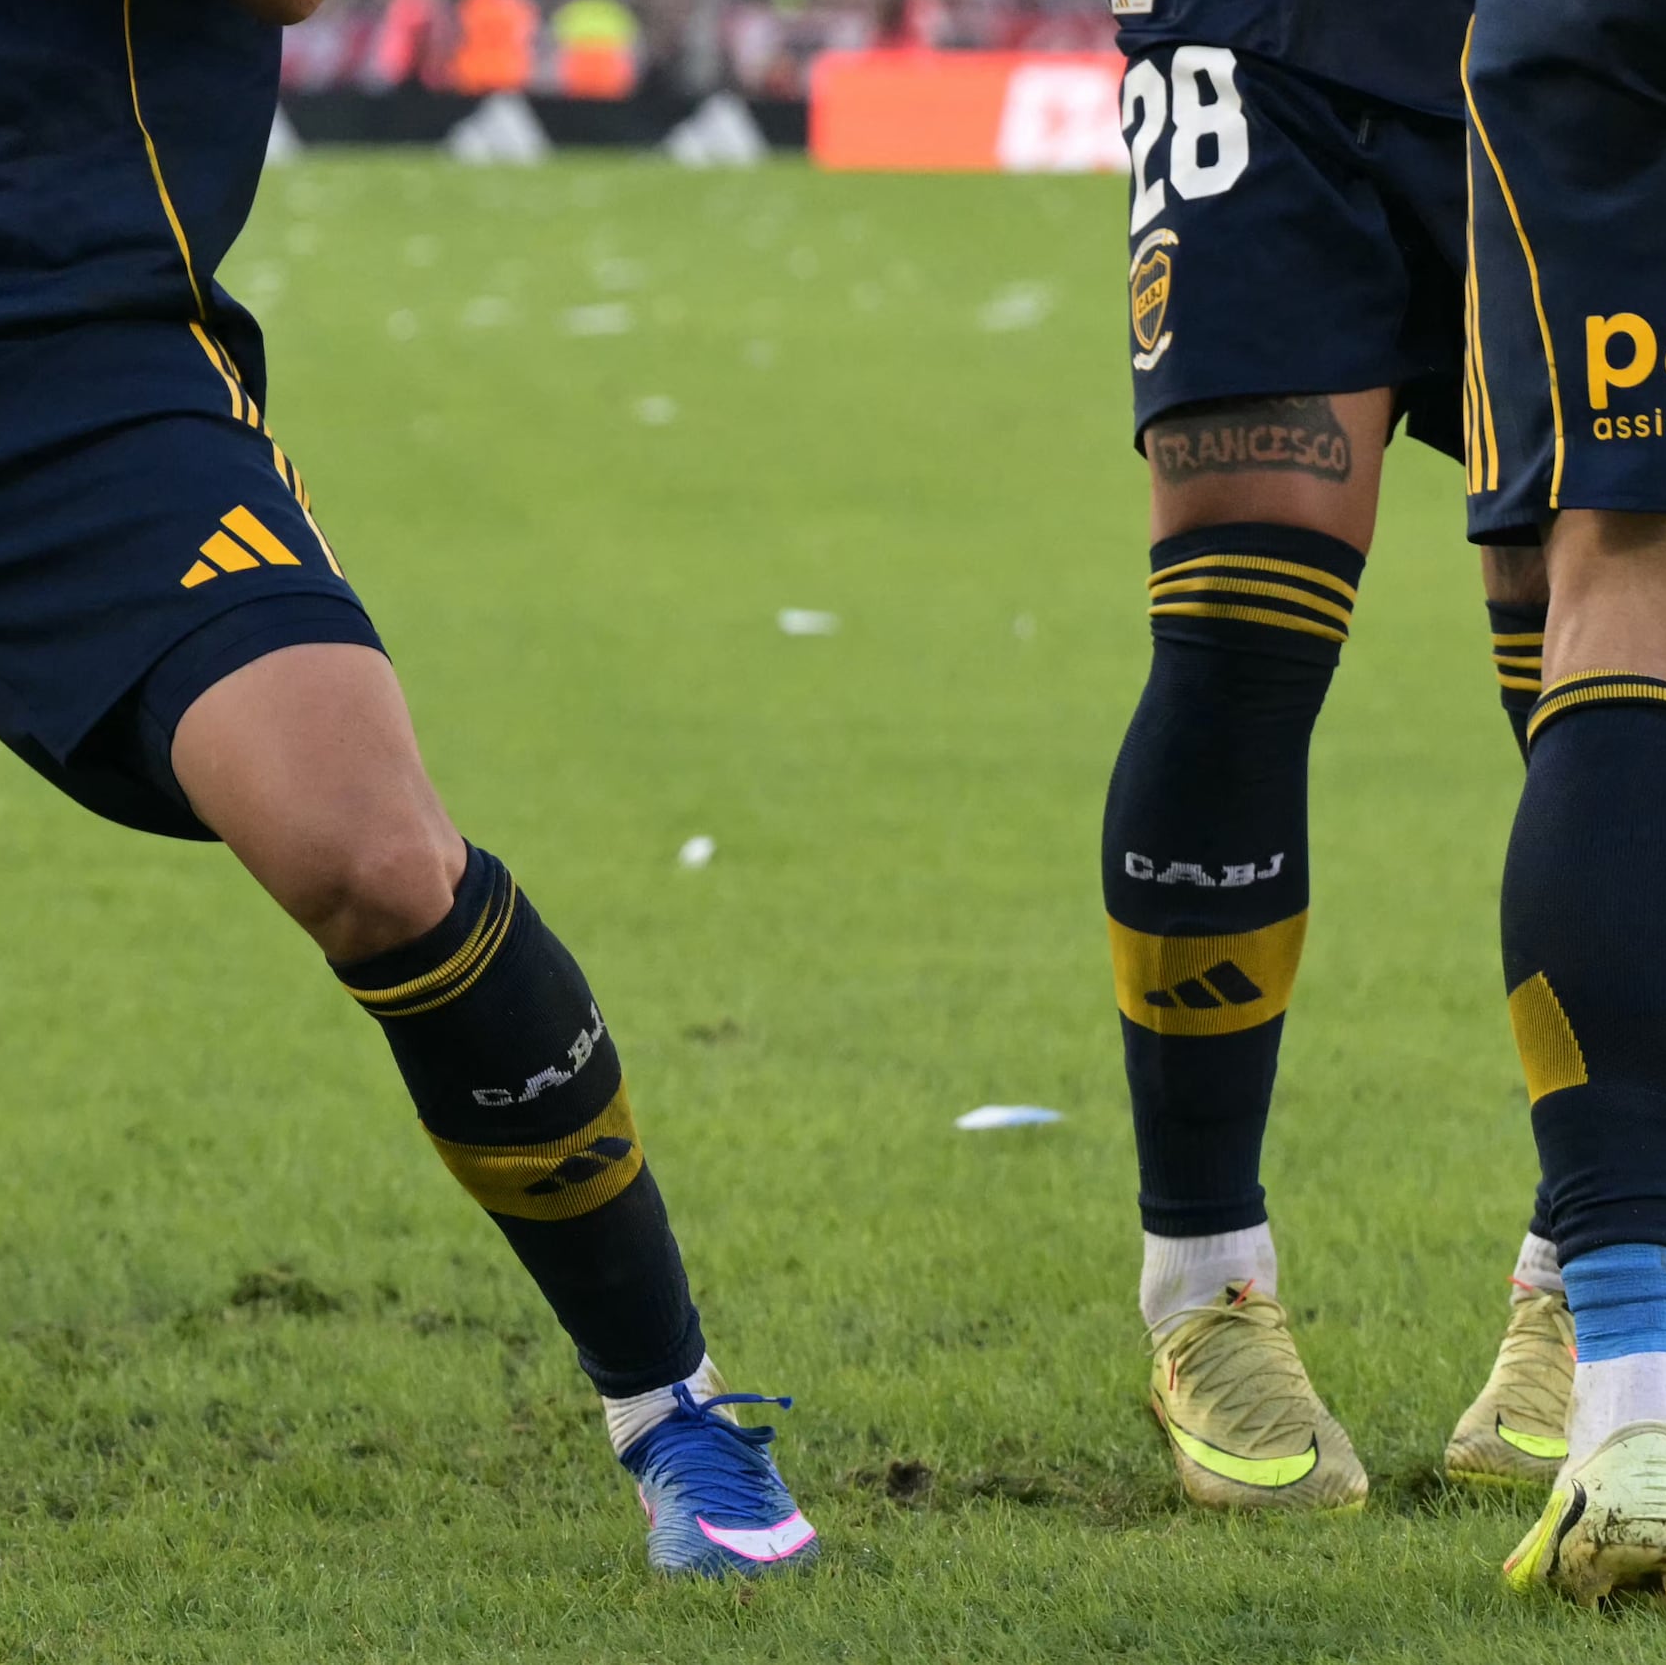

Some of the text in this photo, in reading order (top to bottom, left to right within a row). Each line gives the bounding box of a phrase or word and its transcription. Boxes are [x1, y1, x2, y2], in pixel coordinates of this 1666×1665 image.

[1121, 45, 1250, 237] 28
[1158, 423, 1347, 472] FRANCESCO
[1124, 851, 1285, 887] CABJ
